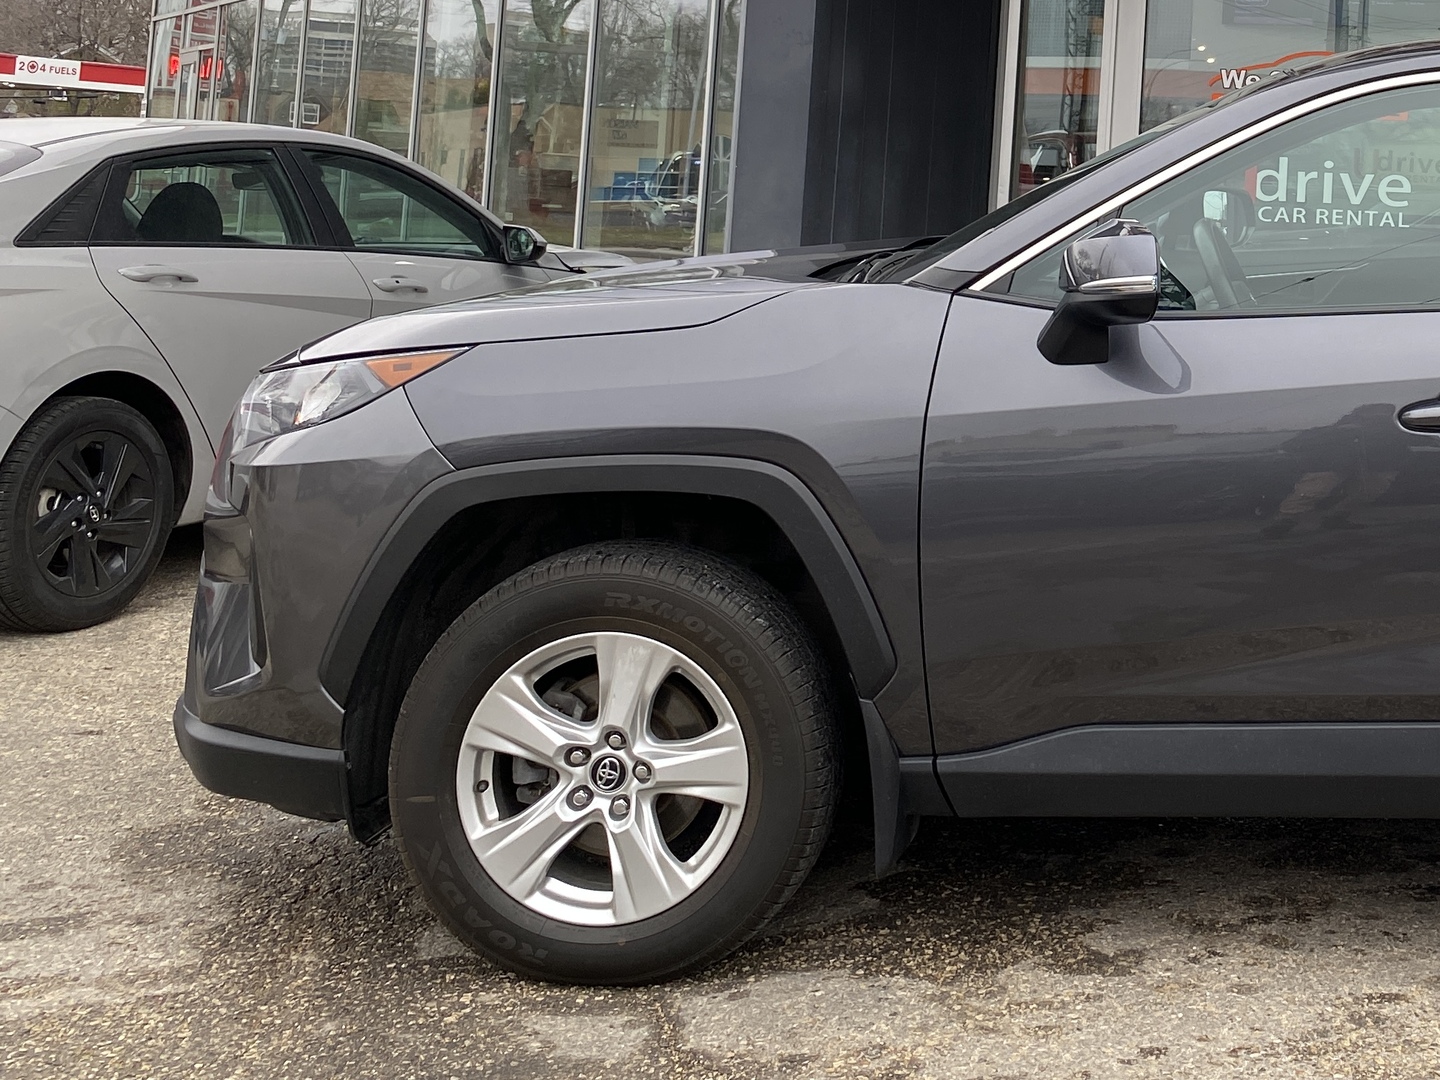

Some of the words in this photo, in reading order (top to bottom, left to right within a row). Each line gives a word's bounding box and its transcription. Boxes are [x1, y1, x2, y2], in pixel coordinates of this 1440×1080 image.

[49, 65, 77, 76] FUELS
[1257, 206, 1307, 224] CAR
[1315, 209, 1411, 228] RENTAL
[603, 590, 764, 690] RXMOTION
[412, 838, 549, 967] ROADX
